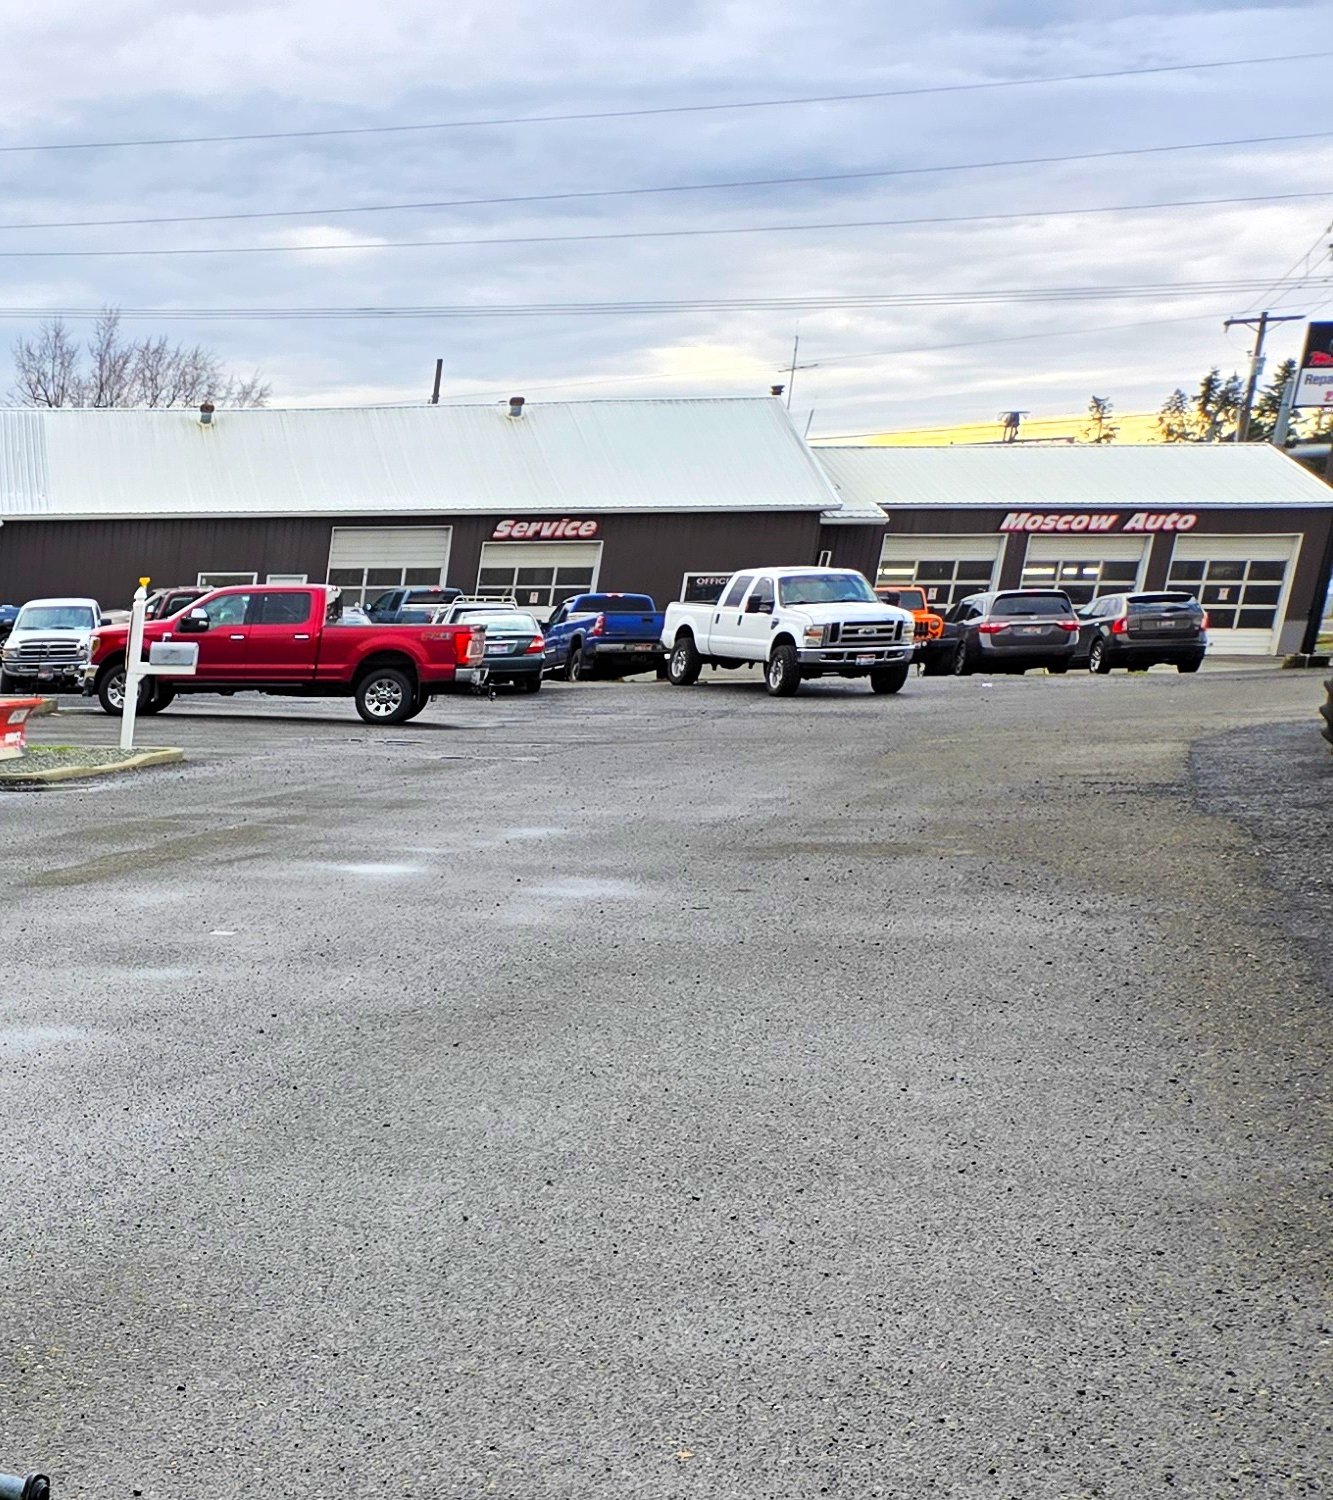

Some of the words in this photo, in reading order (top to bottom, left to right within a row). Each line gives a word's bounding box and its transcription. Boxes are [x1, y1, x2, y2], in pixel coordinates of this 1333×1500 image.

[492, 518, 598, 539] Service
[999, 512, 1119, 531] Moscow
[1123, 512, 1197, 531] Auto
[696, 577, 729, 586] OFFIC
